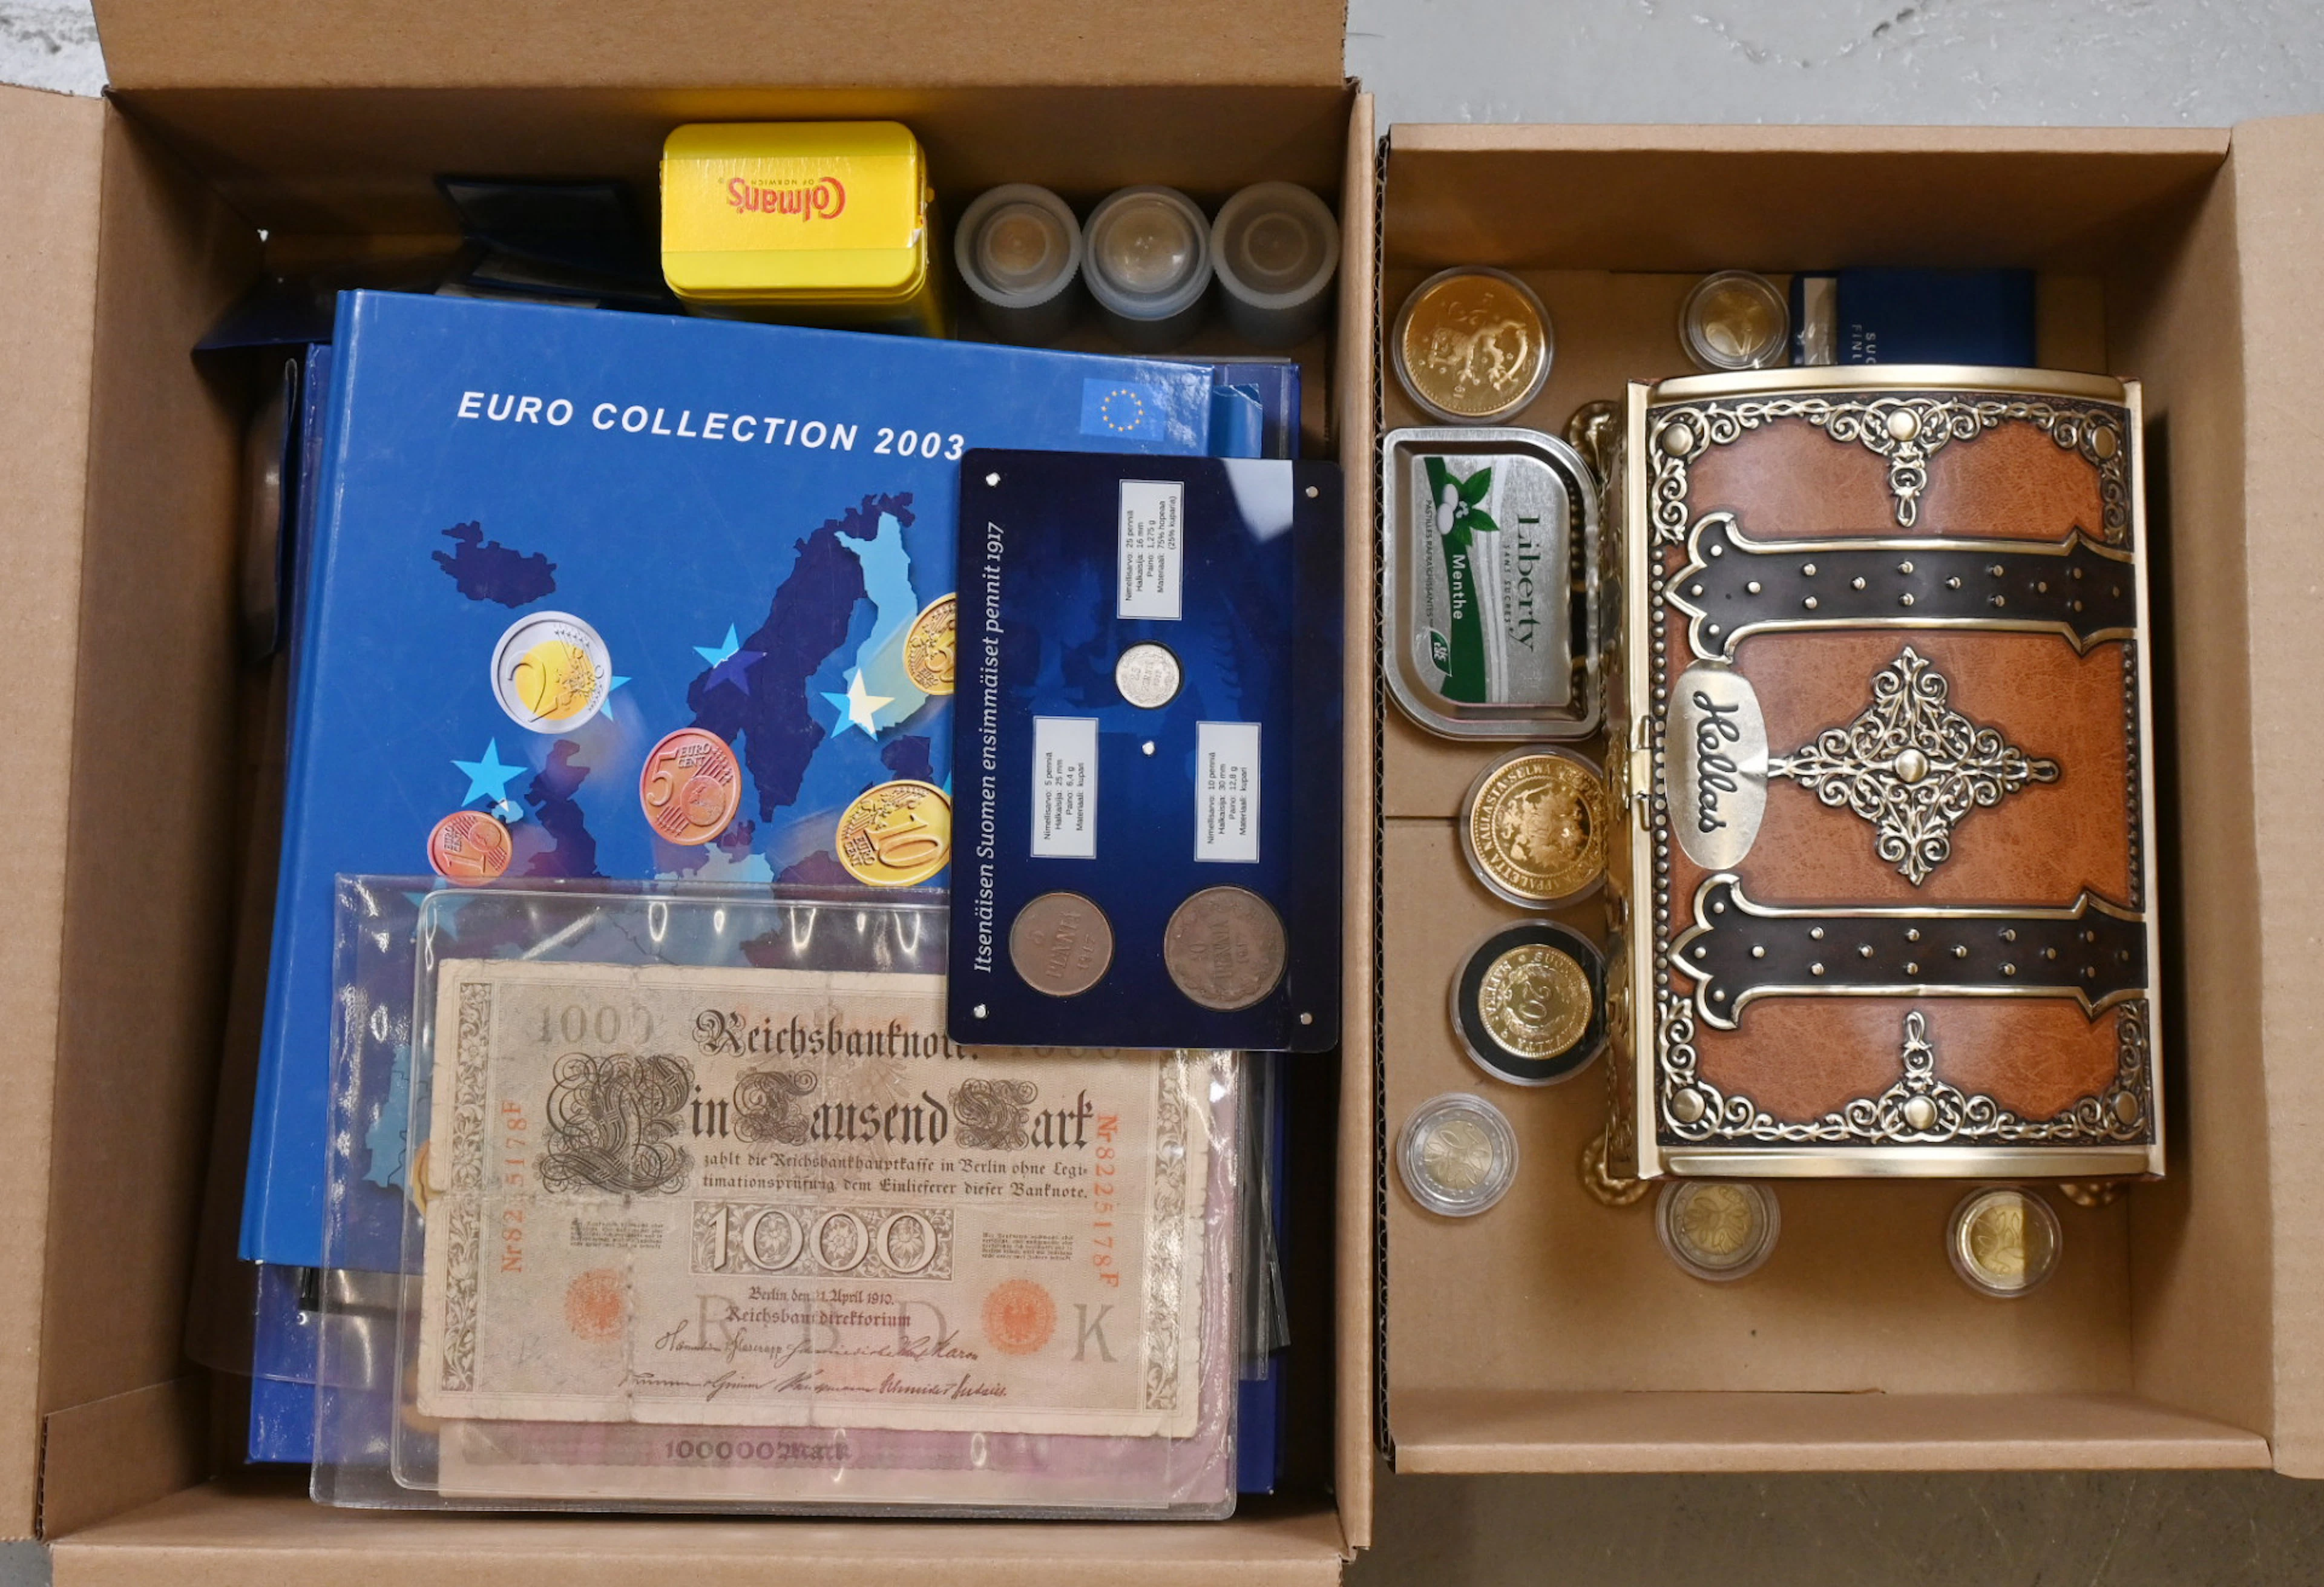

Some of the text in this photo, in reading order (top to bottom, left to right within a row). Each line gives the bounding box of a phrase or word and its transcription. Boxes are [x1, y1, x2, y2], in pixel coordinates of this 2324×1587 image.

[727, 176, 845, 222] Colman's
[458, 391, 965, 461] EURO COLLECTION 2003
[1138, 522, 1144, 536] mm
[1137, 538, 1144, 548] 16
[1452, 554, 1463, 620] Menthe
[1508, 515, 1541, 652] Liberty
[680, 743, 712, 757] EURO
[973, 522, 1005, 973] Itsenäisen Suomen ensimmäiset pennit 1917
[678, 757, 705, 769] CENT
[1057, 758, 1063, 774] mm
[1219, 763, 1226, 779] mm
[1693, 690, 1740, 833] Hellas
[648, 747, 679, 807] 5
[1055, 777, 1063, 786] 25
[1208, 780, 1215, 790] 10
[1218, 780, 1226, 791] 30
[1229, 774, 1238, 790] 12,8
[1043, 789, 1052, 840] Nimellisarvo:
[843, 841, 863, 867] CENT
[856, 835, 875, 866] EURO
[862, 813, 943, 870] 10
[442, 851, 486, 875] 1
[1096, 1113, 1119, 1143] Nr
[703, 1152, 740, 1168] zahlt
[748, 1152, 767, 1166] die
[940, 1157, 954, 1172] in
[958, 1158, 1006, 1174] Berlin
[1012, 1160, 1046, 1179] ohne
[501, 1099, 527, 1273] Nr 825178F
[842, 1177, 872, 1192] dem
[1010, 1181, 1088, 1199] Banknote.
[709, 1207, 937, 1272] 1000
[749, 1286, 786, 1302] Berlin
[791, 1288, 810, 1302] den
[828, 1288, 864, 1306] April
[867, 1292, 894, 1306] 1910.
[1073, 1303, 1120, 1363] K
